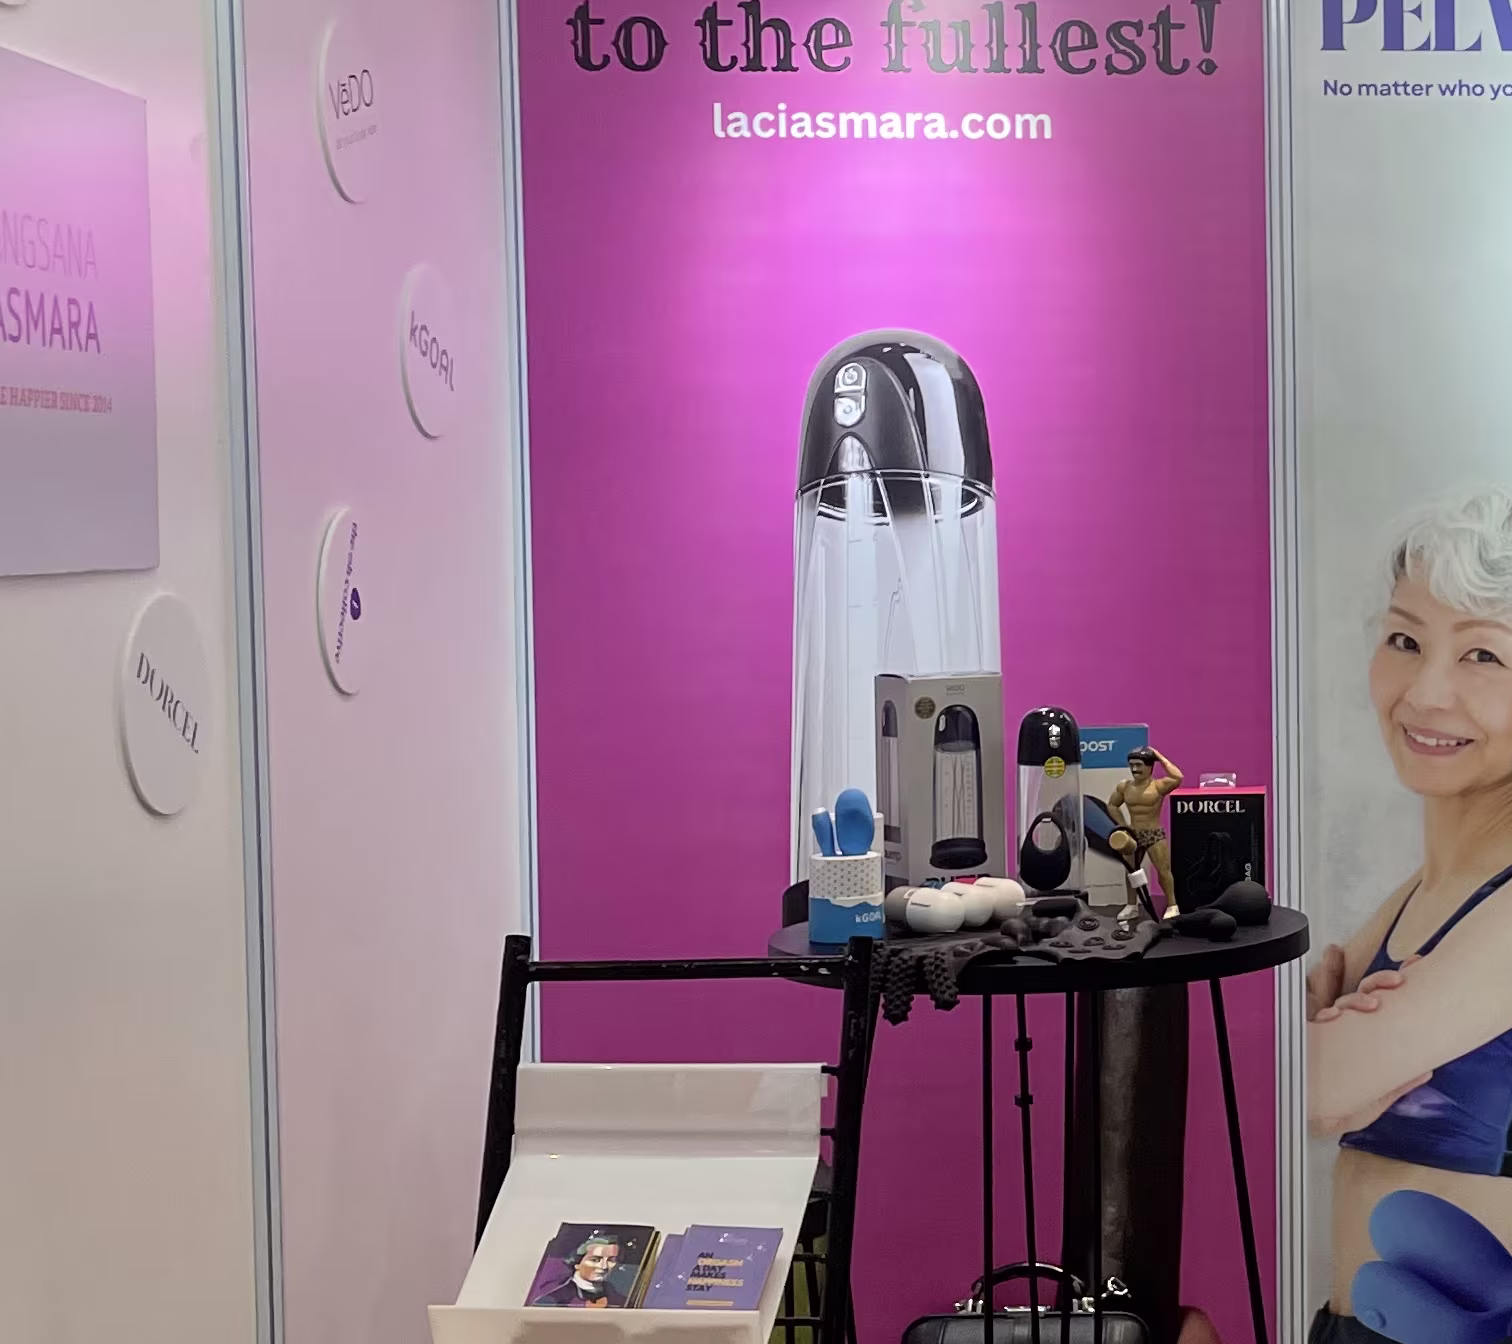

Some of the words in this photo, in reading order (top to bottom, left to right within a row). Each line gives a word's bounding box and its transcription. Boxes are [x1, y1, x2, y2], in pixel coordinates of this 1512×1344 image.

[565, 0, 668, 73] to
[1323, 79, 1353, 97] No
[1357, 80, 1433, 97] matter
[1438, 78, 1485, 97] who
[713, 103, 1052, 140] laciasmara.com
[0, 209, 98, 279] NGSANA
[137, 652, 199, 754] DORCEL
[1177, 800, 1246, 814] DORCEL
